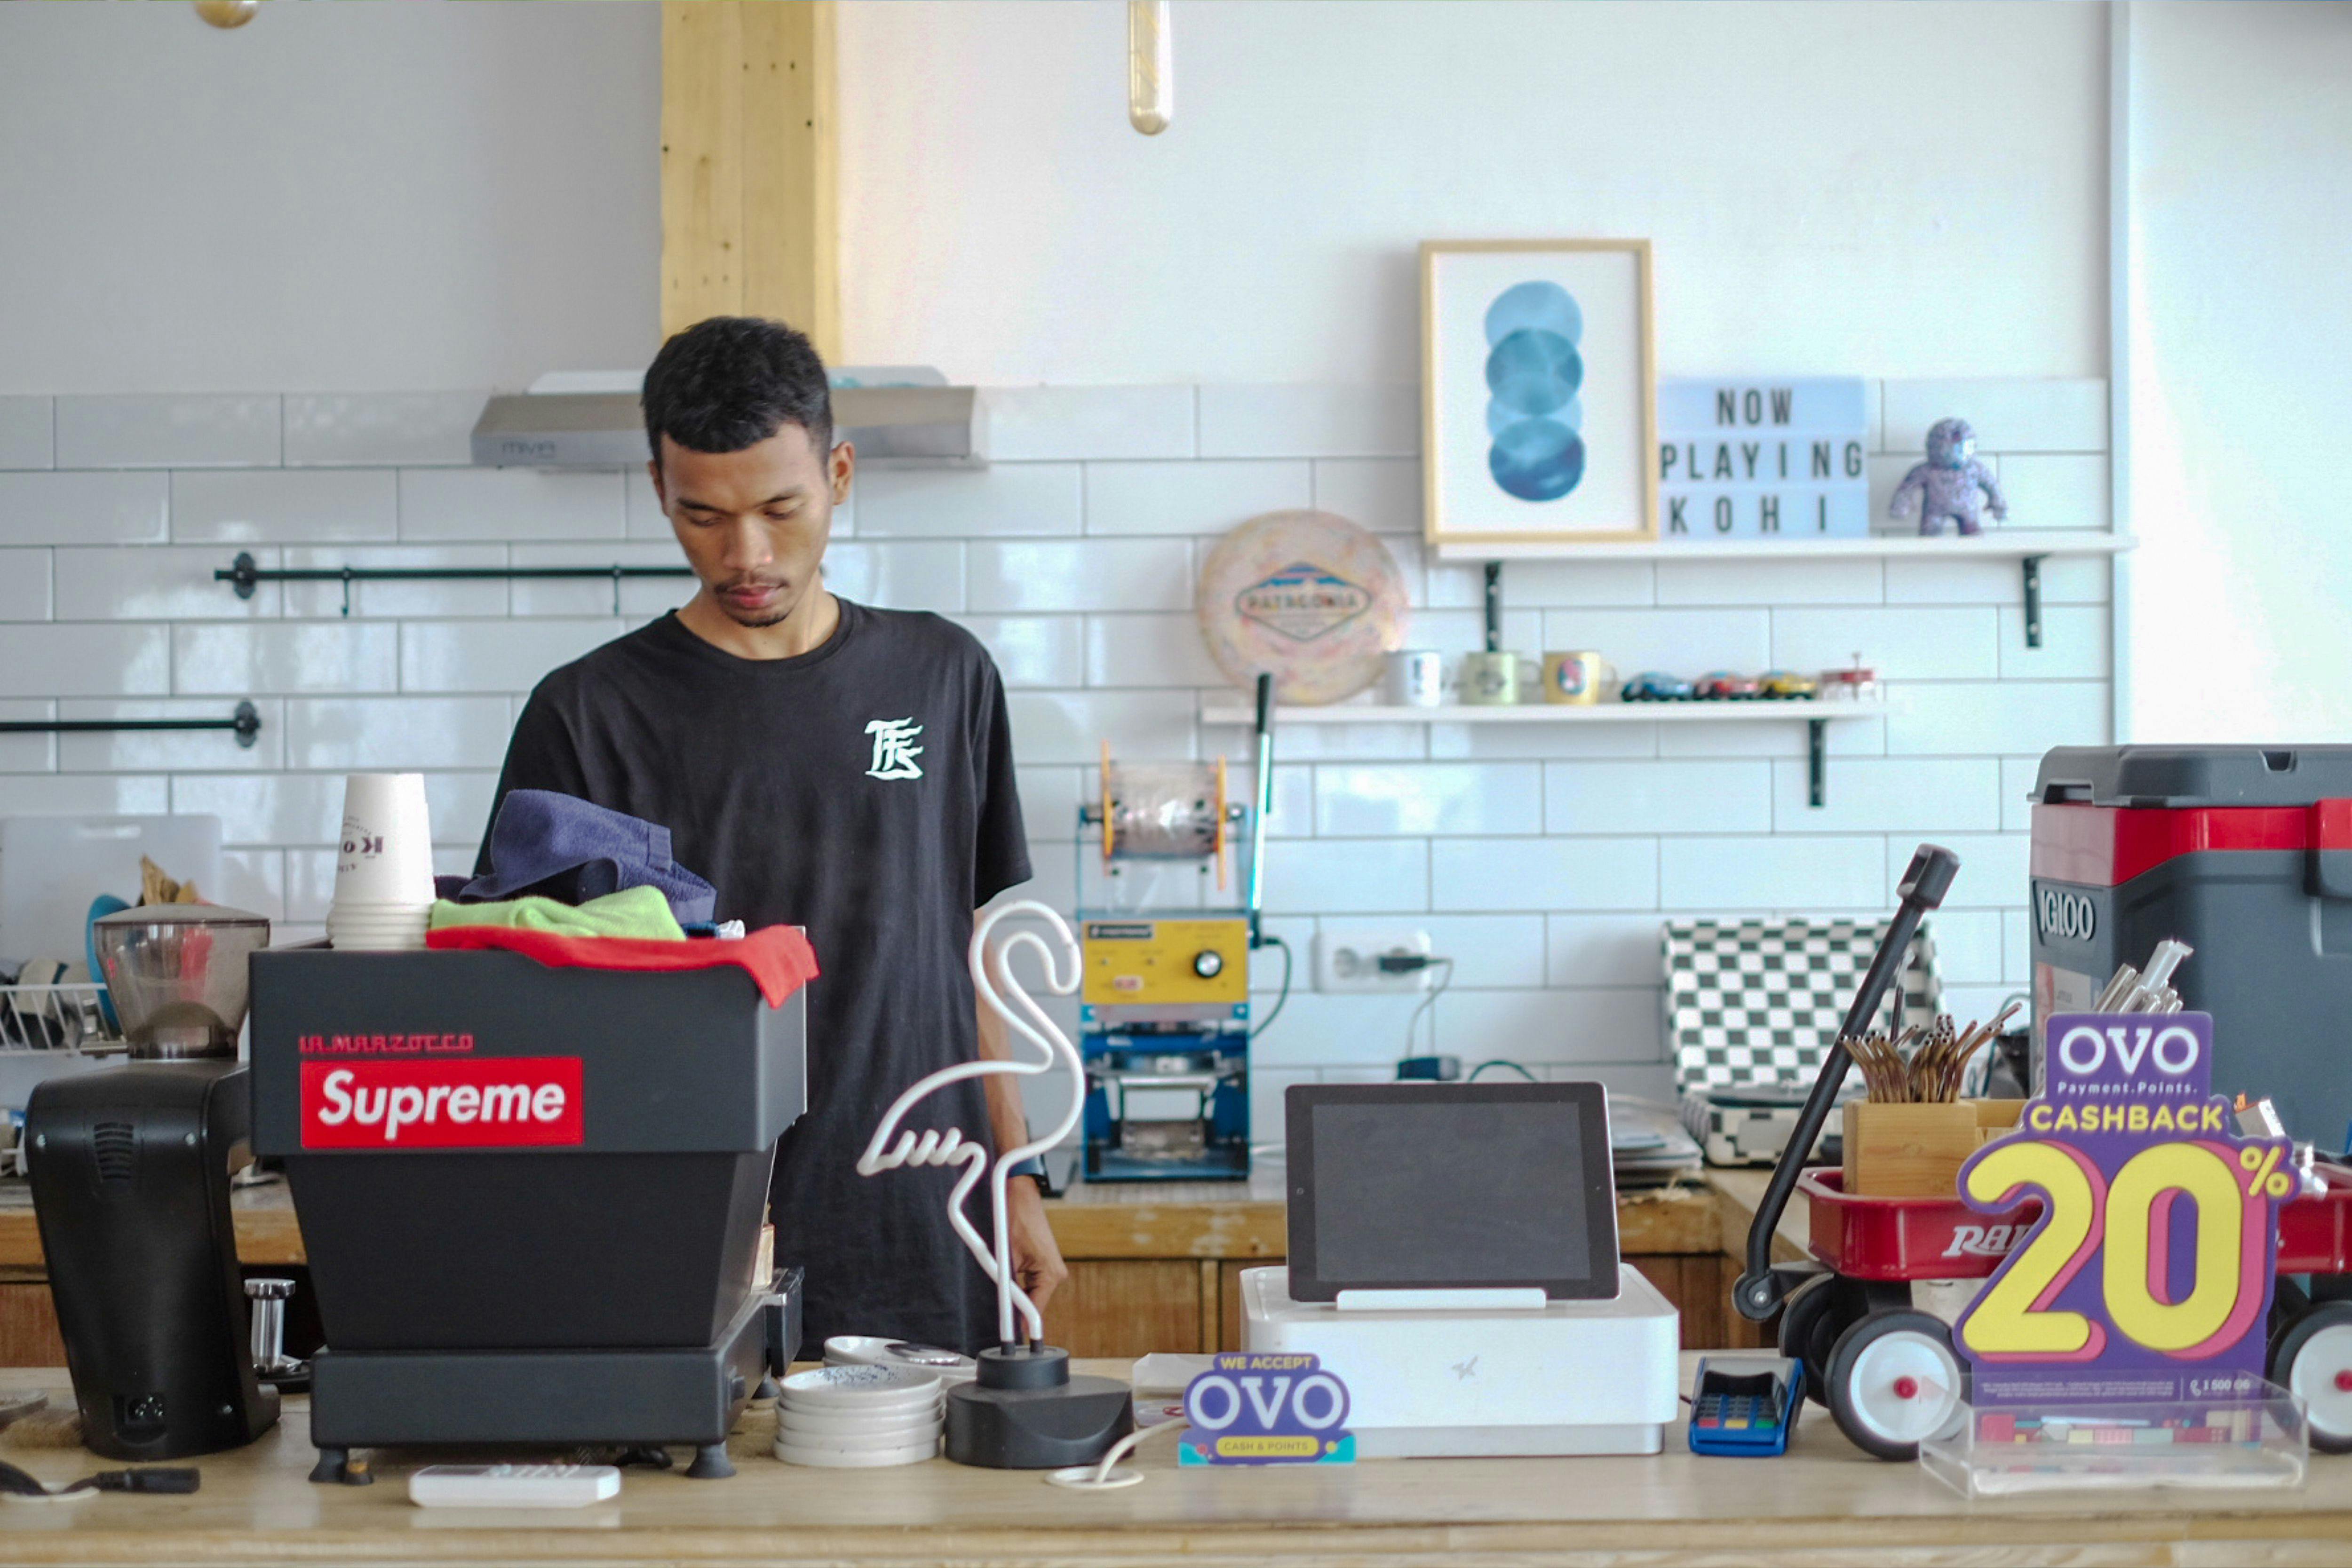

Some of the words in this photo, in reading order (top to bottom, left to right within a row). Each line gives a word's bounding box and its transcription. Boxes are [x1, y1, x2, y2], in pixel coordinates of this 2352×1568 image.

[1717, 388, 1792, 424] NOW
[1661, 441, 1862, 479] PLAYING
[1670, 496, 1826, 532] KOHI
[2040, 889, 2095, 941] IGLOO
[2058, 1026, 2199, 1075] OVO
[318, 1070, 565, 1140] Supreme
[2030, 1104, 2224, 1131] CASHBACK
[1220, 1357, 1246, 1369] WE
[1251, 1356, 1312, 1369] ACCEPT
[1189, 1374, 1343, 1430] OVO
[1224, 1441, 1254, 1450] CASH
[1257, 1441, 1264, 1450] &
[1268, 1441, 1309, 1450] POINTS
